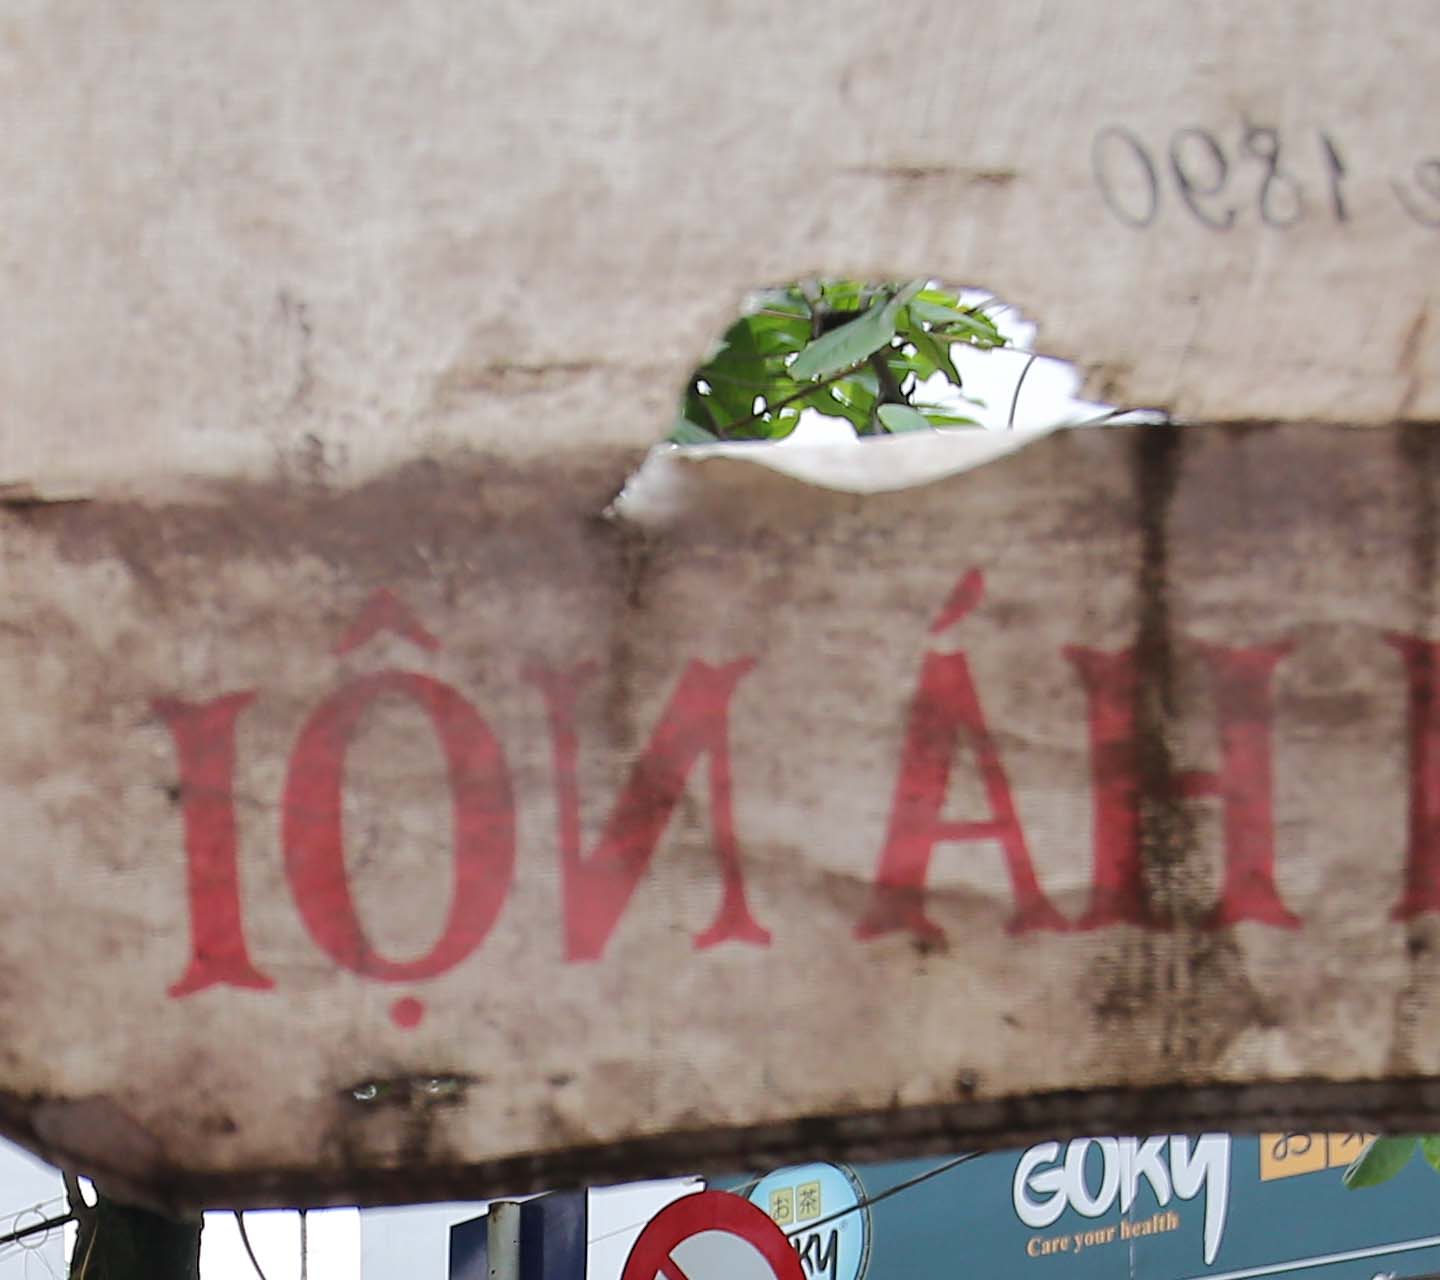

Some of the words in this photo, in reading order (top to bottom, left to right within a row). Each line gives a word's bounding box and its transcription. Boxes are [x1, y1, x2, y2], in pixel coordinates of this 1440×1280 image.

[1013, 1131, 1232, 1266] GOKY
[1027, 1235, 1069, 1258] Care
[1073, 1225, 1116, 1252] your
[1120, 1210, 1180, 1241] health
